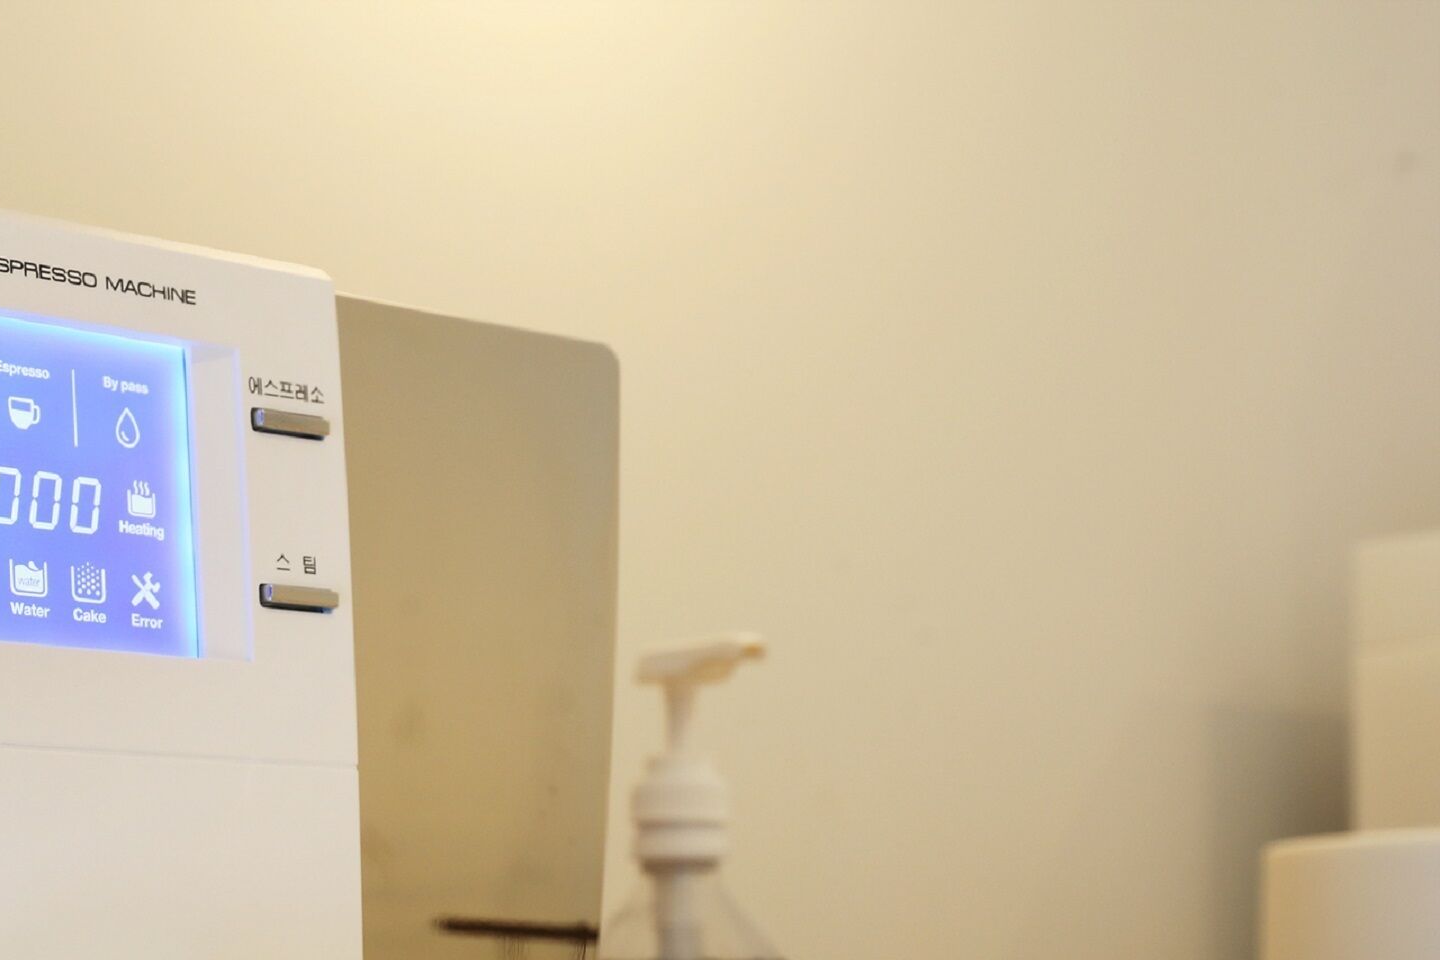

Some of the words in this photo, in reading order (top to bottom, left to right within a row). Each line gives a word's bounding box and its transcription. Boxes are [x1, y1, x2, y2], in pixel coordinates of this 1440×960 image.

[104, 276, 197, 306] MACHINE
[102, 374, 121, 392] By
[122, 378, 149, 397] pass
[248, 376, 325, 404] 에스프레소
[118, 519, 165, 542] Heating
[10, 601, 51, 619] Water
[72, 608, 107, 625] Cake
[131, 614, 163, 630] Error
